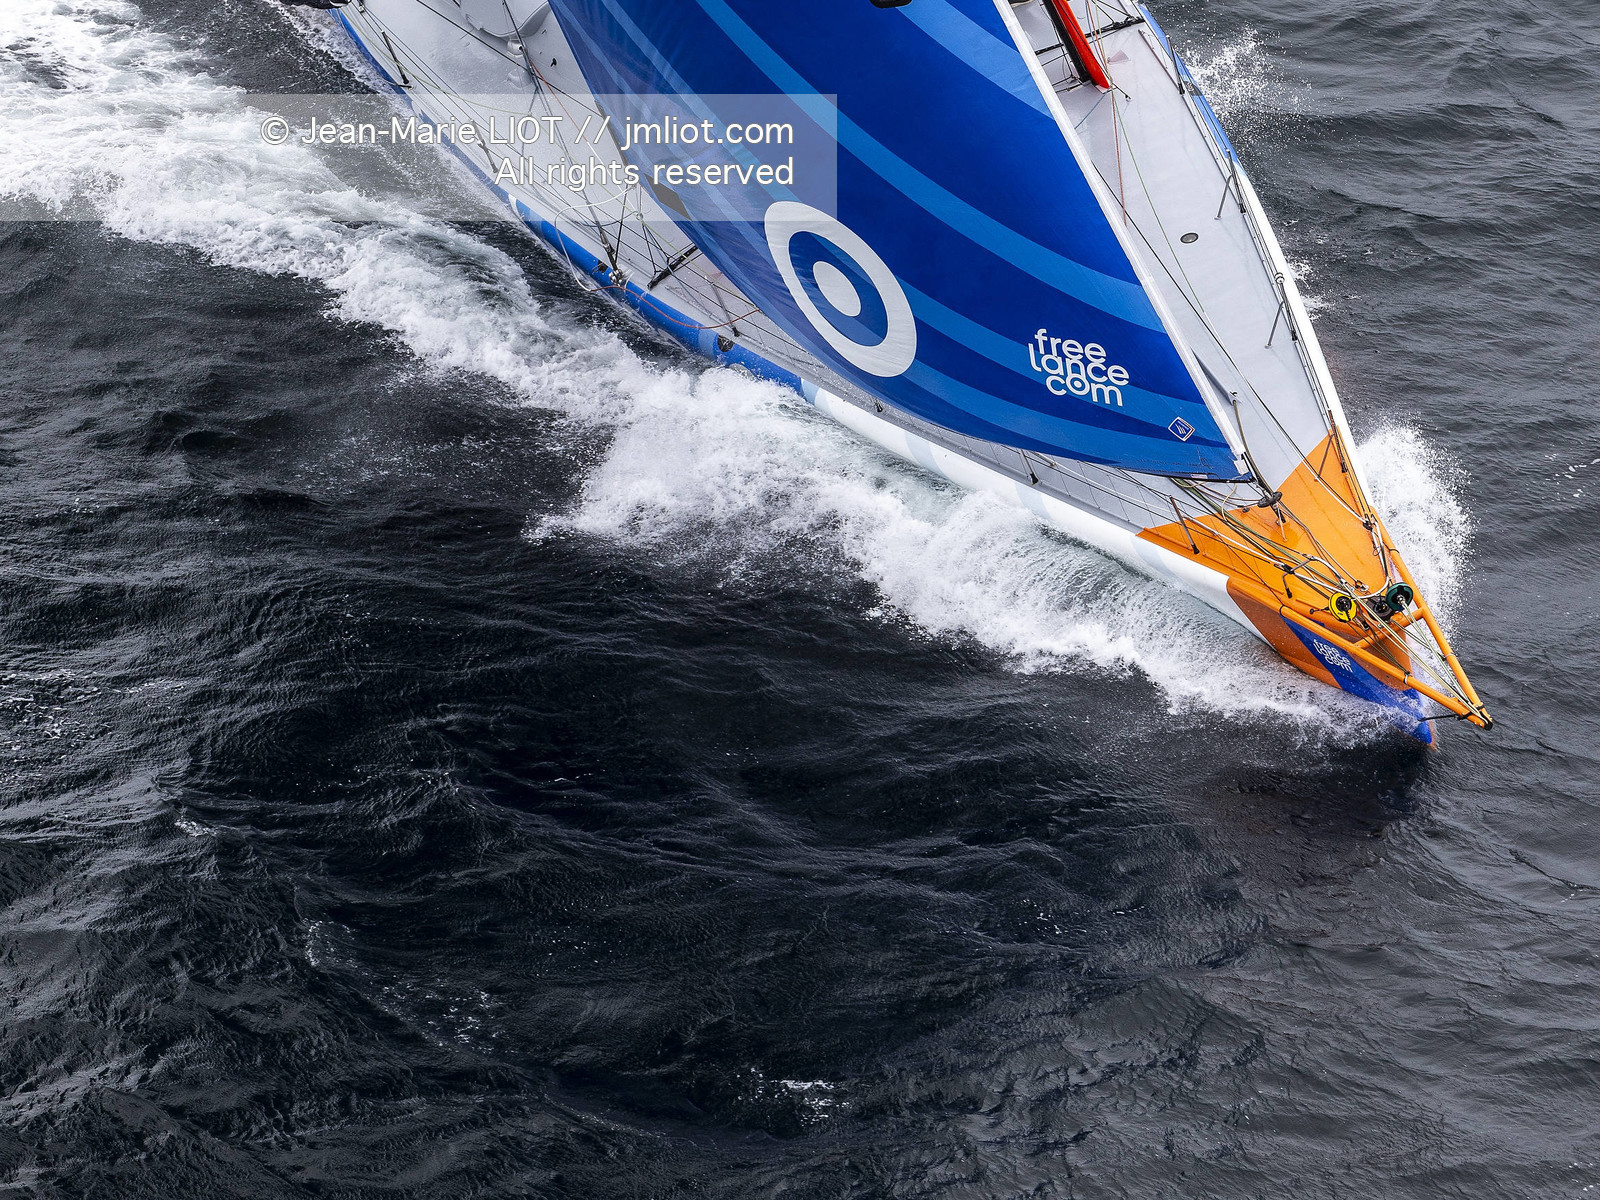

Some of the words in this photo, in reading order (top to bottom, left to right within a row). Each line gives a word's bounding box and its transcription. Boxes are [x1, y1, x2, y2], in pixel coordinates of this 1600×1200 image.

[1034, 328, 1107, 363] free
[1028, 343, 1130, 386] lance
[1045, 375, 1123, 406] com
